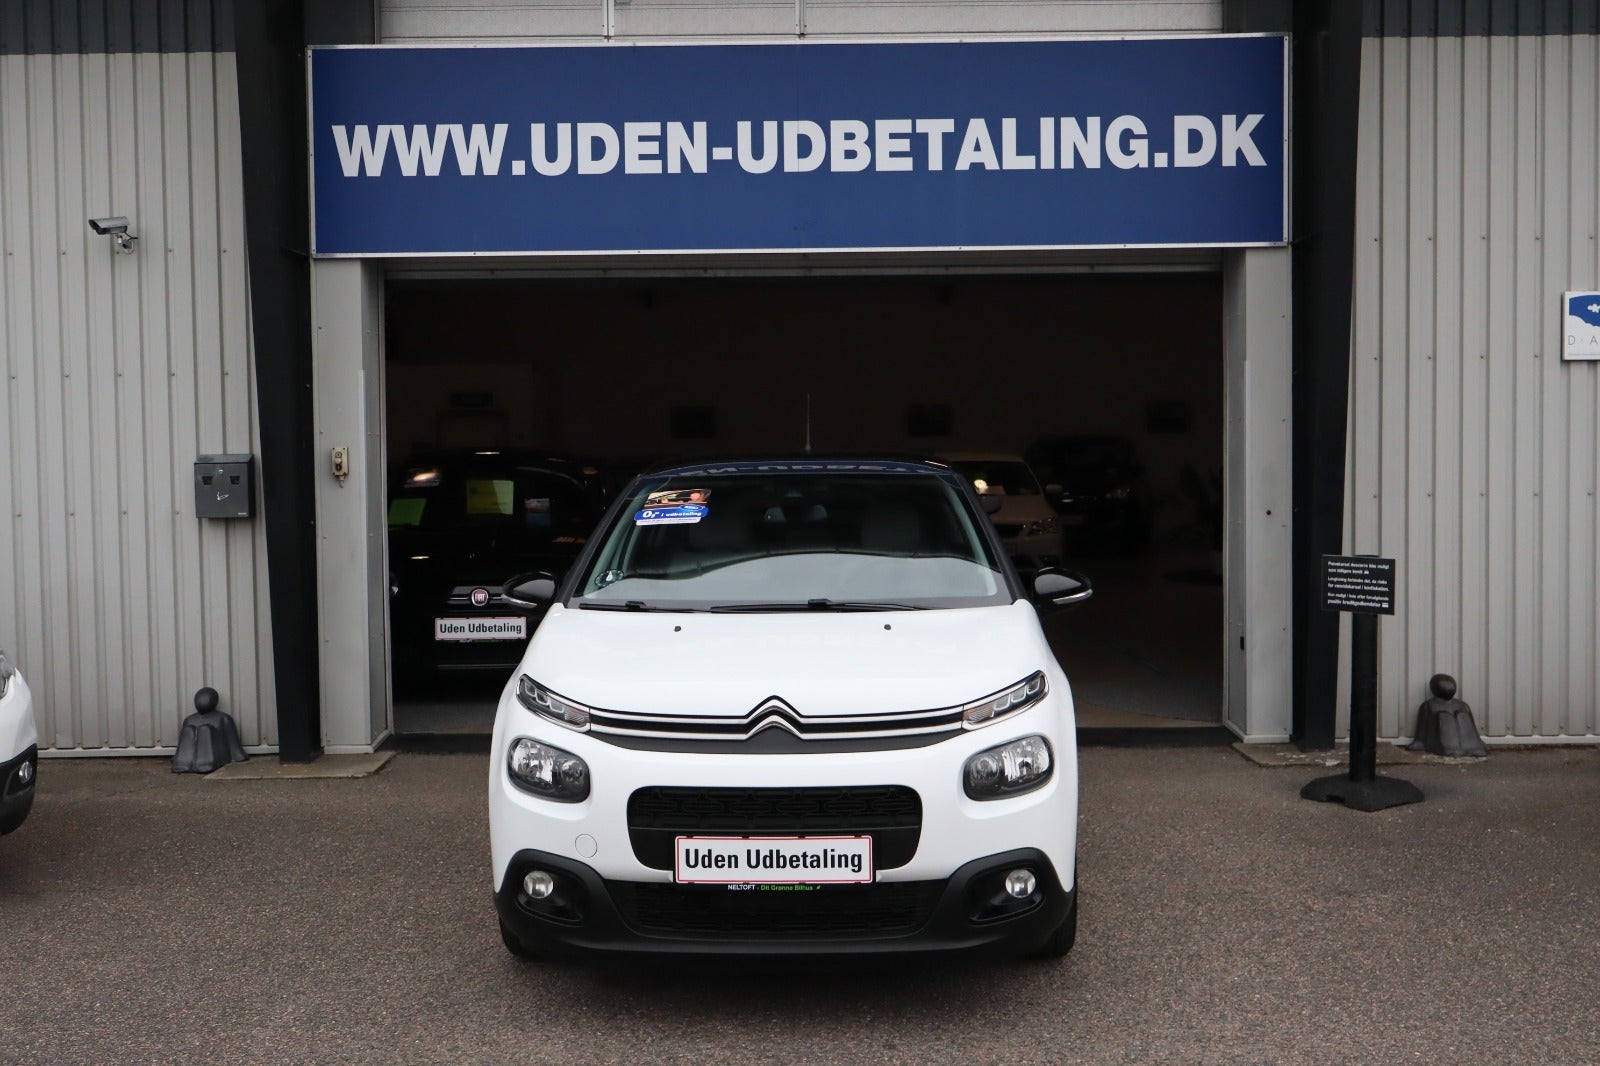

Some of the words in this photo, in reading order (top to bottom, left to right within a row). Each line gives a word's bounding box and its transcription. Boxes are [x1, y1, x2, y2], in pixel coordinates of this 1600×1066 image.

[332, 113, 1267, 178] WWW.UDEN-UDBETALING.DK
[440, 623, 465, 633] Uden
[468, 622, 522, 634] Udbetaling
[685, 848, 739, 869] Uden
[746, 848, 863, 873] Udbetaling
